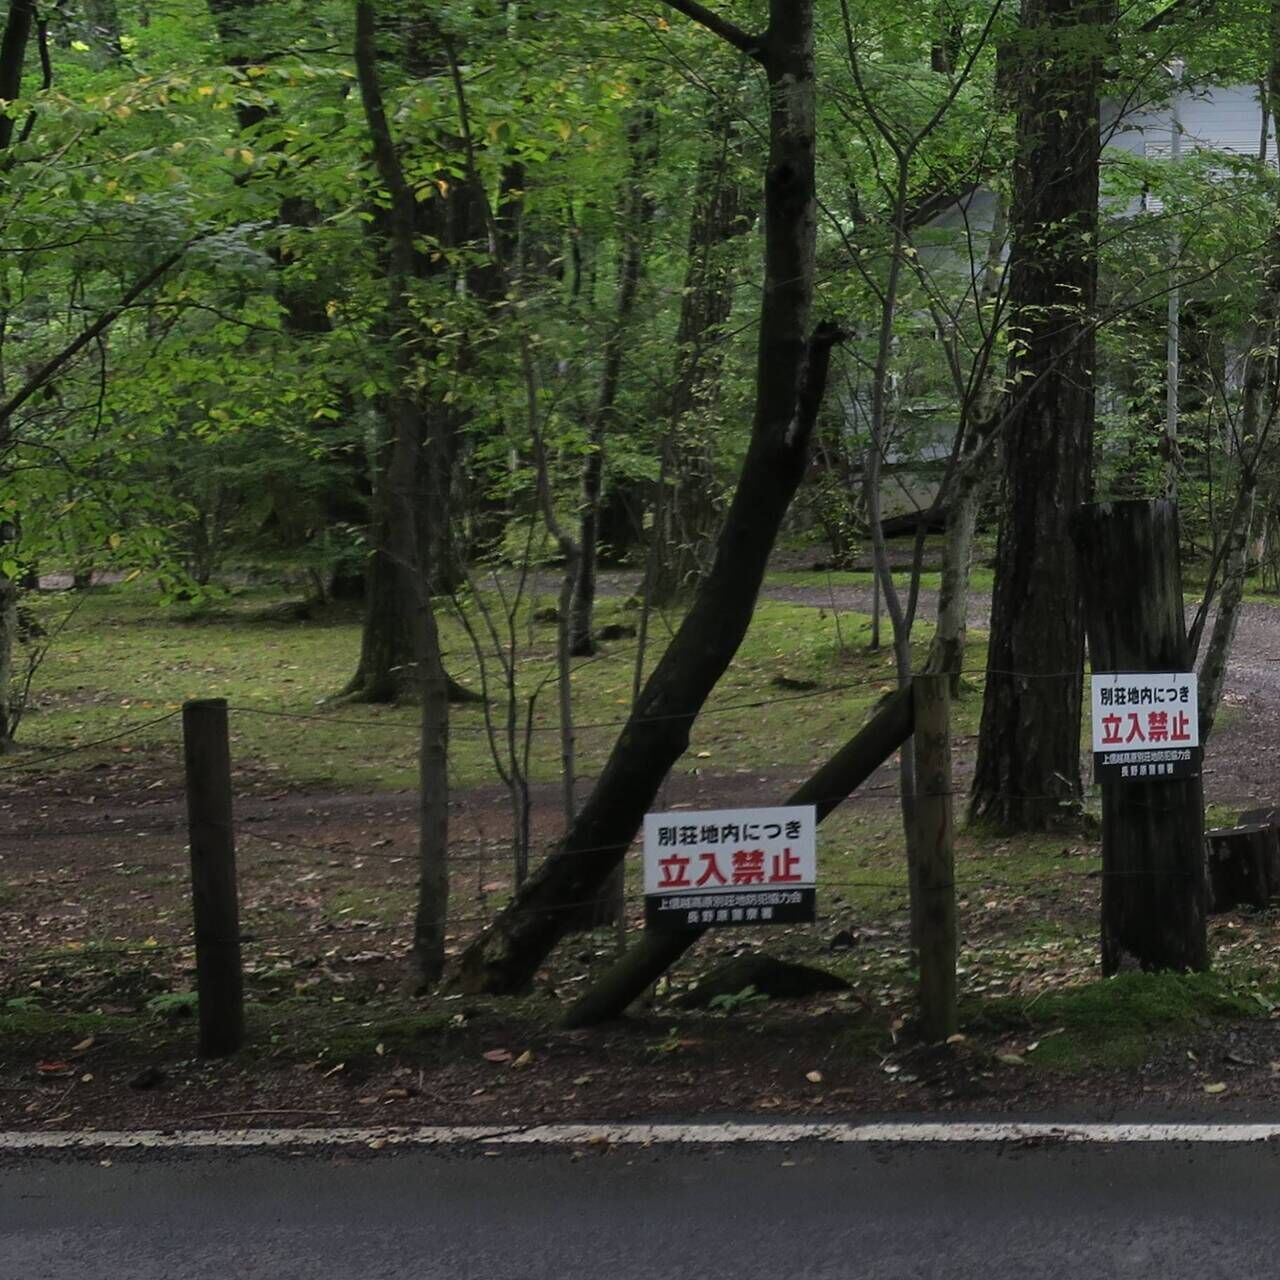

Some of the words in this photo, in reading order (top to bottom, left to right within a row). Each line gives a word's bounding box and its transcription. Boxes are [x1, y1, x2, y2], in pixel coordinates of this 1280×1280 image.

[1100, 686, 1189, 705] 別荘地内につき
[1101, 710, 1191, 744] 立入禁止
[658, 821, 802, 846] 別荘地内につき
[657, 848, 802, 888] 立入禁止
